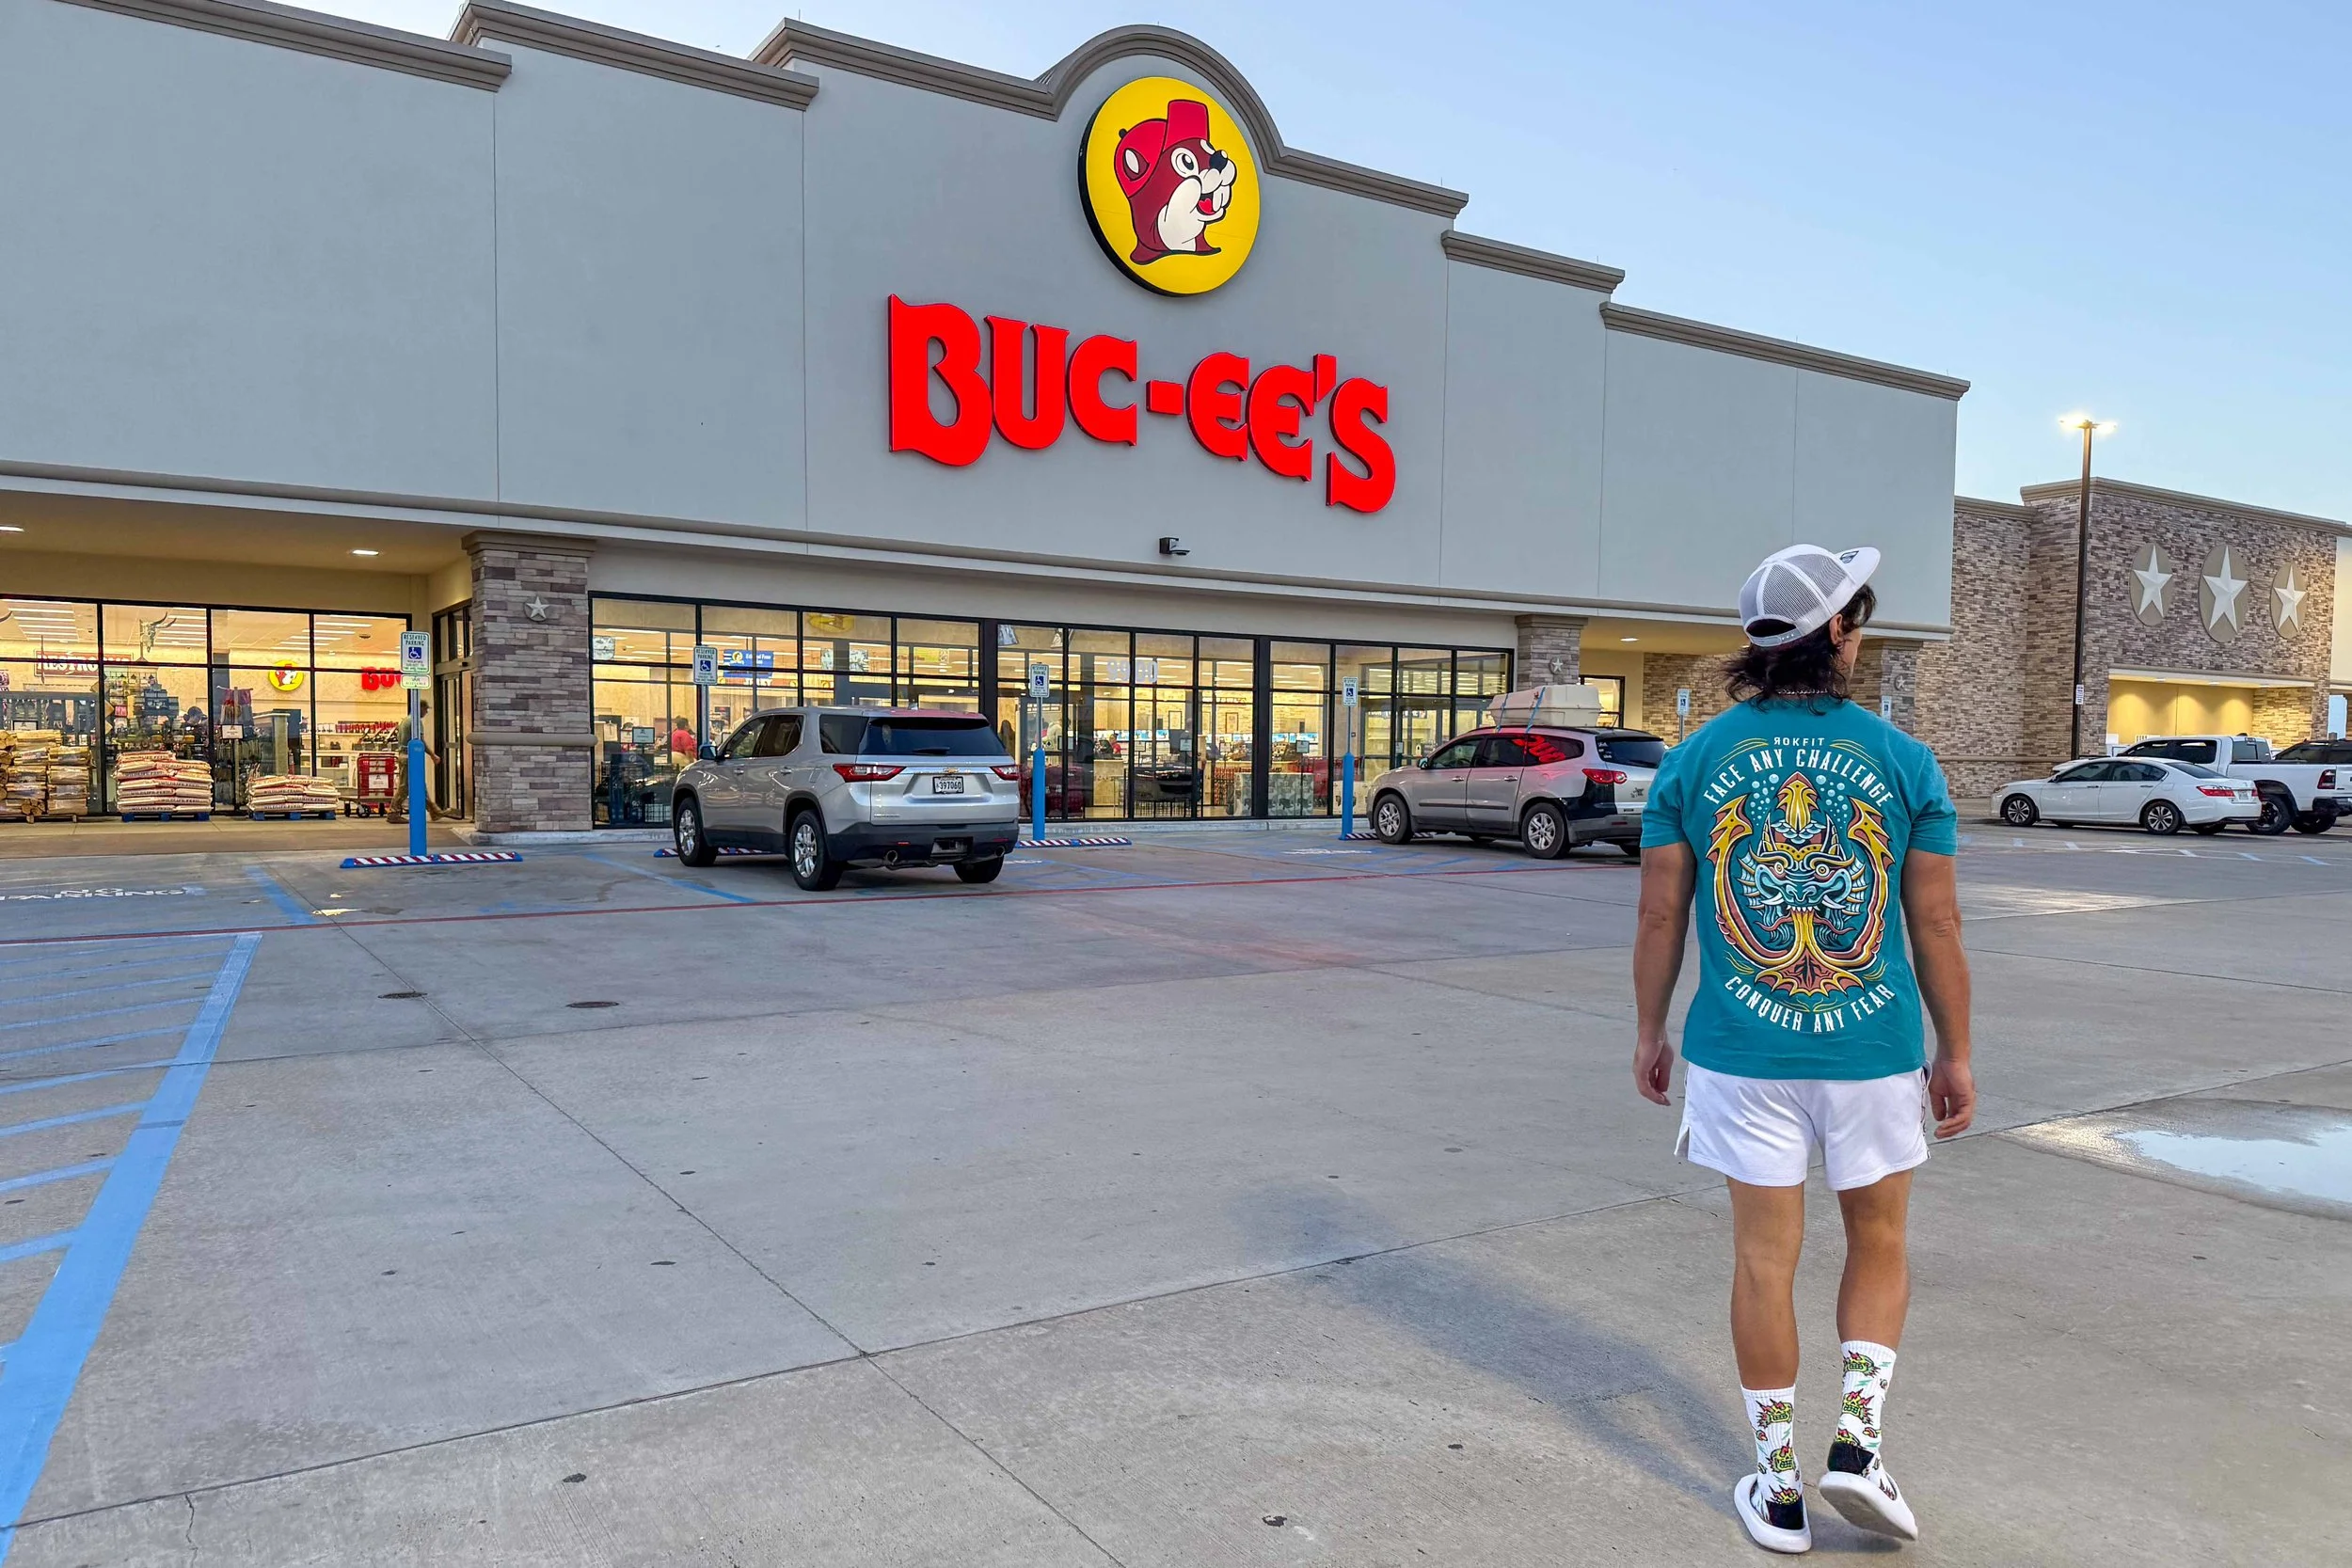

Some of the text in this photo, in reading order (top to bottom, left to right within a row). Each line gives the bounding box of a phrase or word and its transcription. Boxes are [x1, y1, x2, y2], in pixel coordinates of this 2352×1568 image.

[887, 293, 1396, 514] BUC-EE'S
[1704, 748, 1894, 807] FACE ANY CHALLENGE
[0, 890, 185, 900] PARKING
[1724, 975, 1896, 1033] CONQUER ANY FEAR
